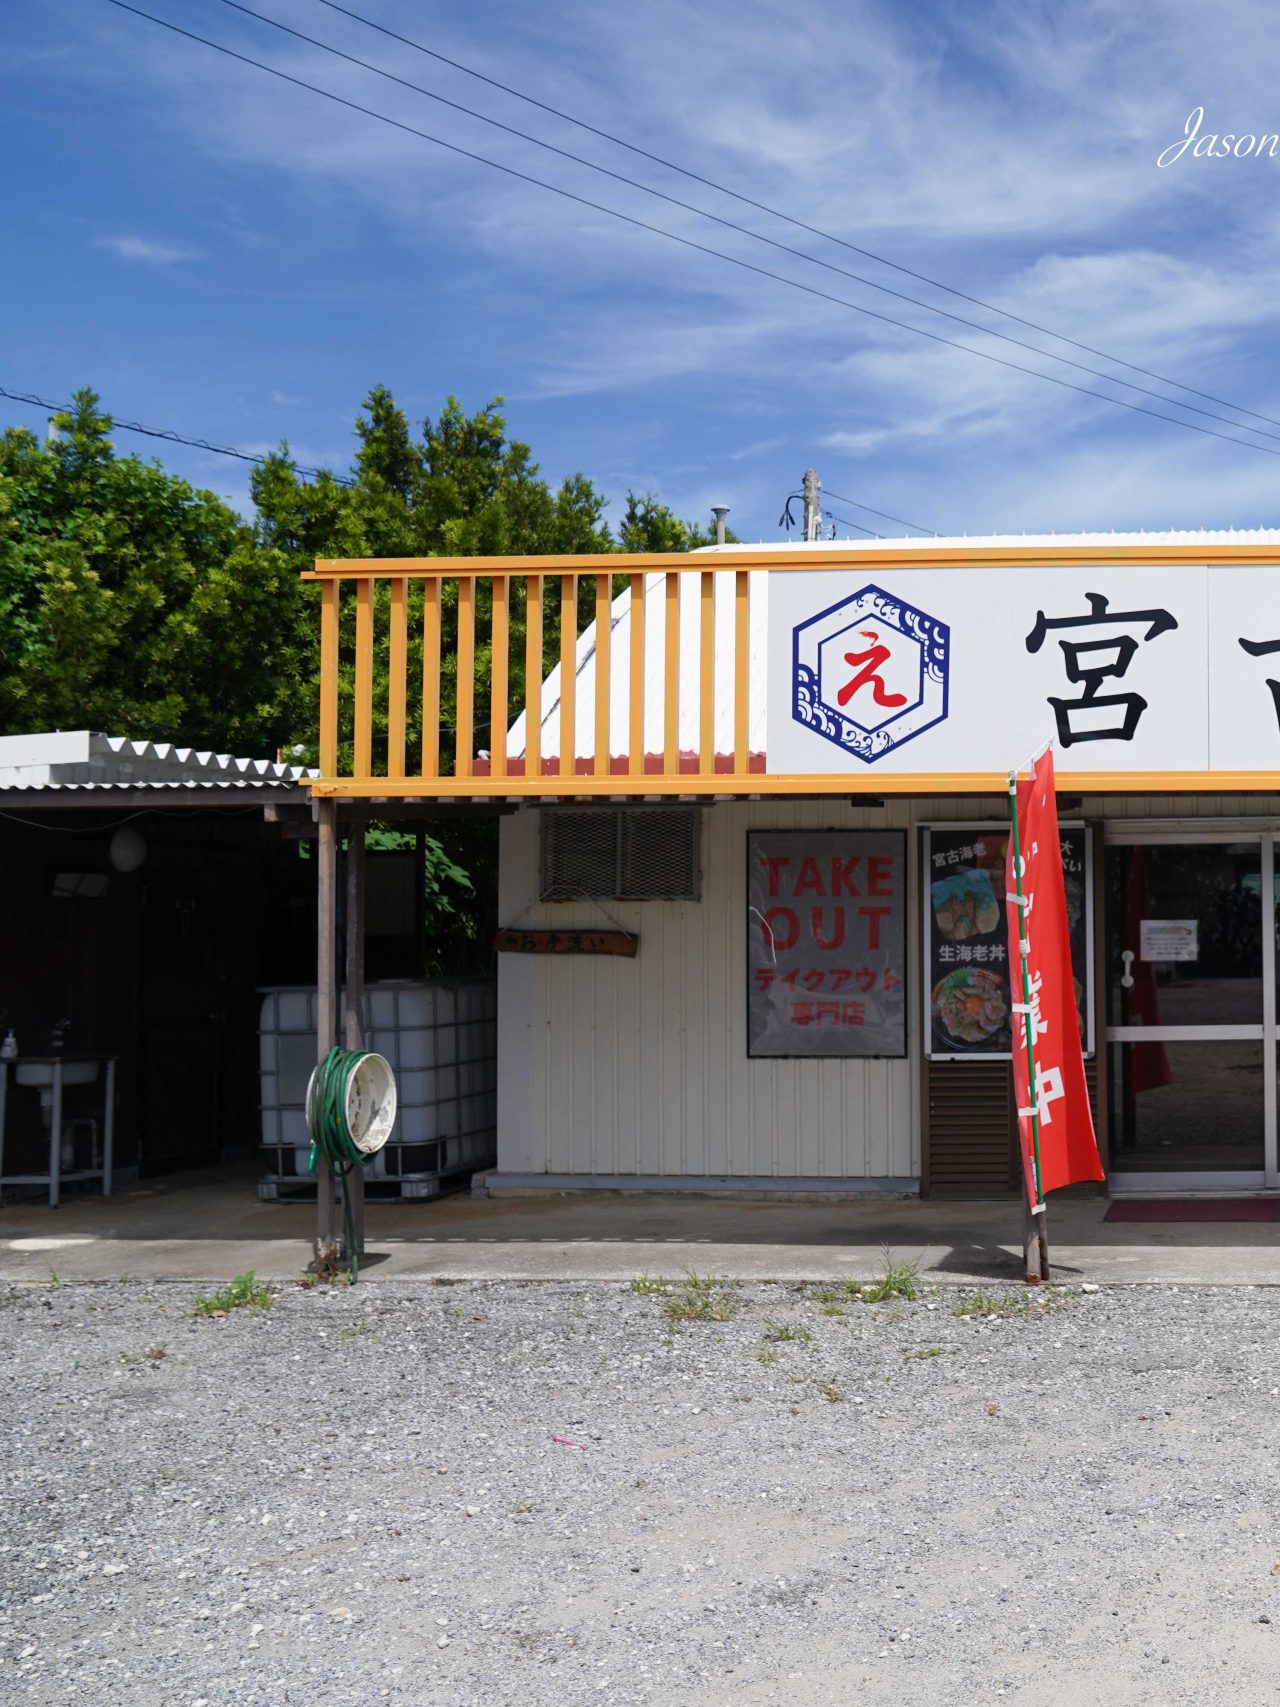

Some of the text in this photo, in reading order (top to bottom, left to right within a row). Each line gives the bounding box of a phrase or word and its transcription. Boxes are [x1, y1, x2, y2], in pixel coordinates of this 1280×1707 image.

[836, 630, 908, 709] え
[932, 841, 987, 868] 宮古海老
[757, 855, 894, 897] TAKE
[760, 906, 891, 951] OUT
[938, 944, 1006, 962] 生海老丼
[754, 966, 903, 993] テイクアウト
[790, 1000, 866, 1027] 専門店
